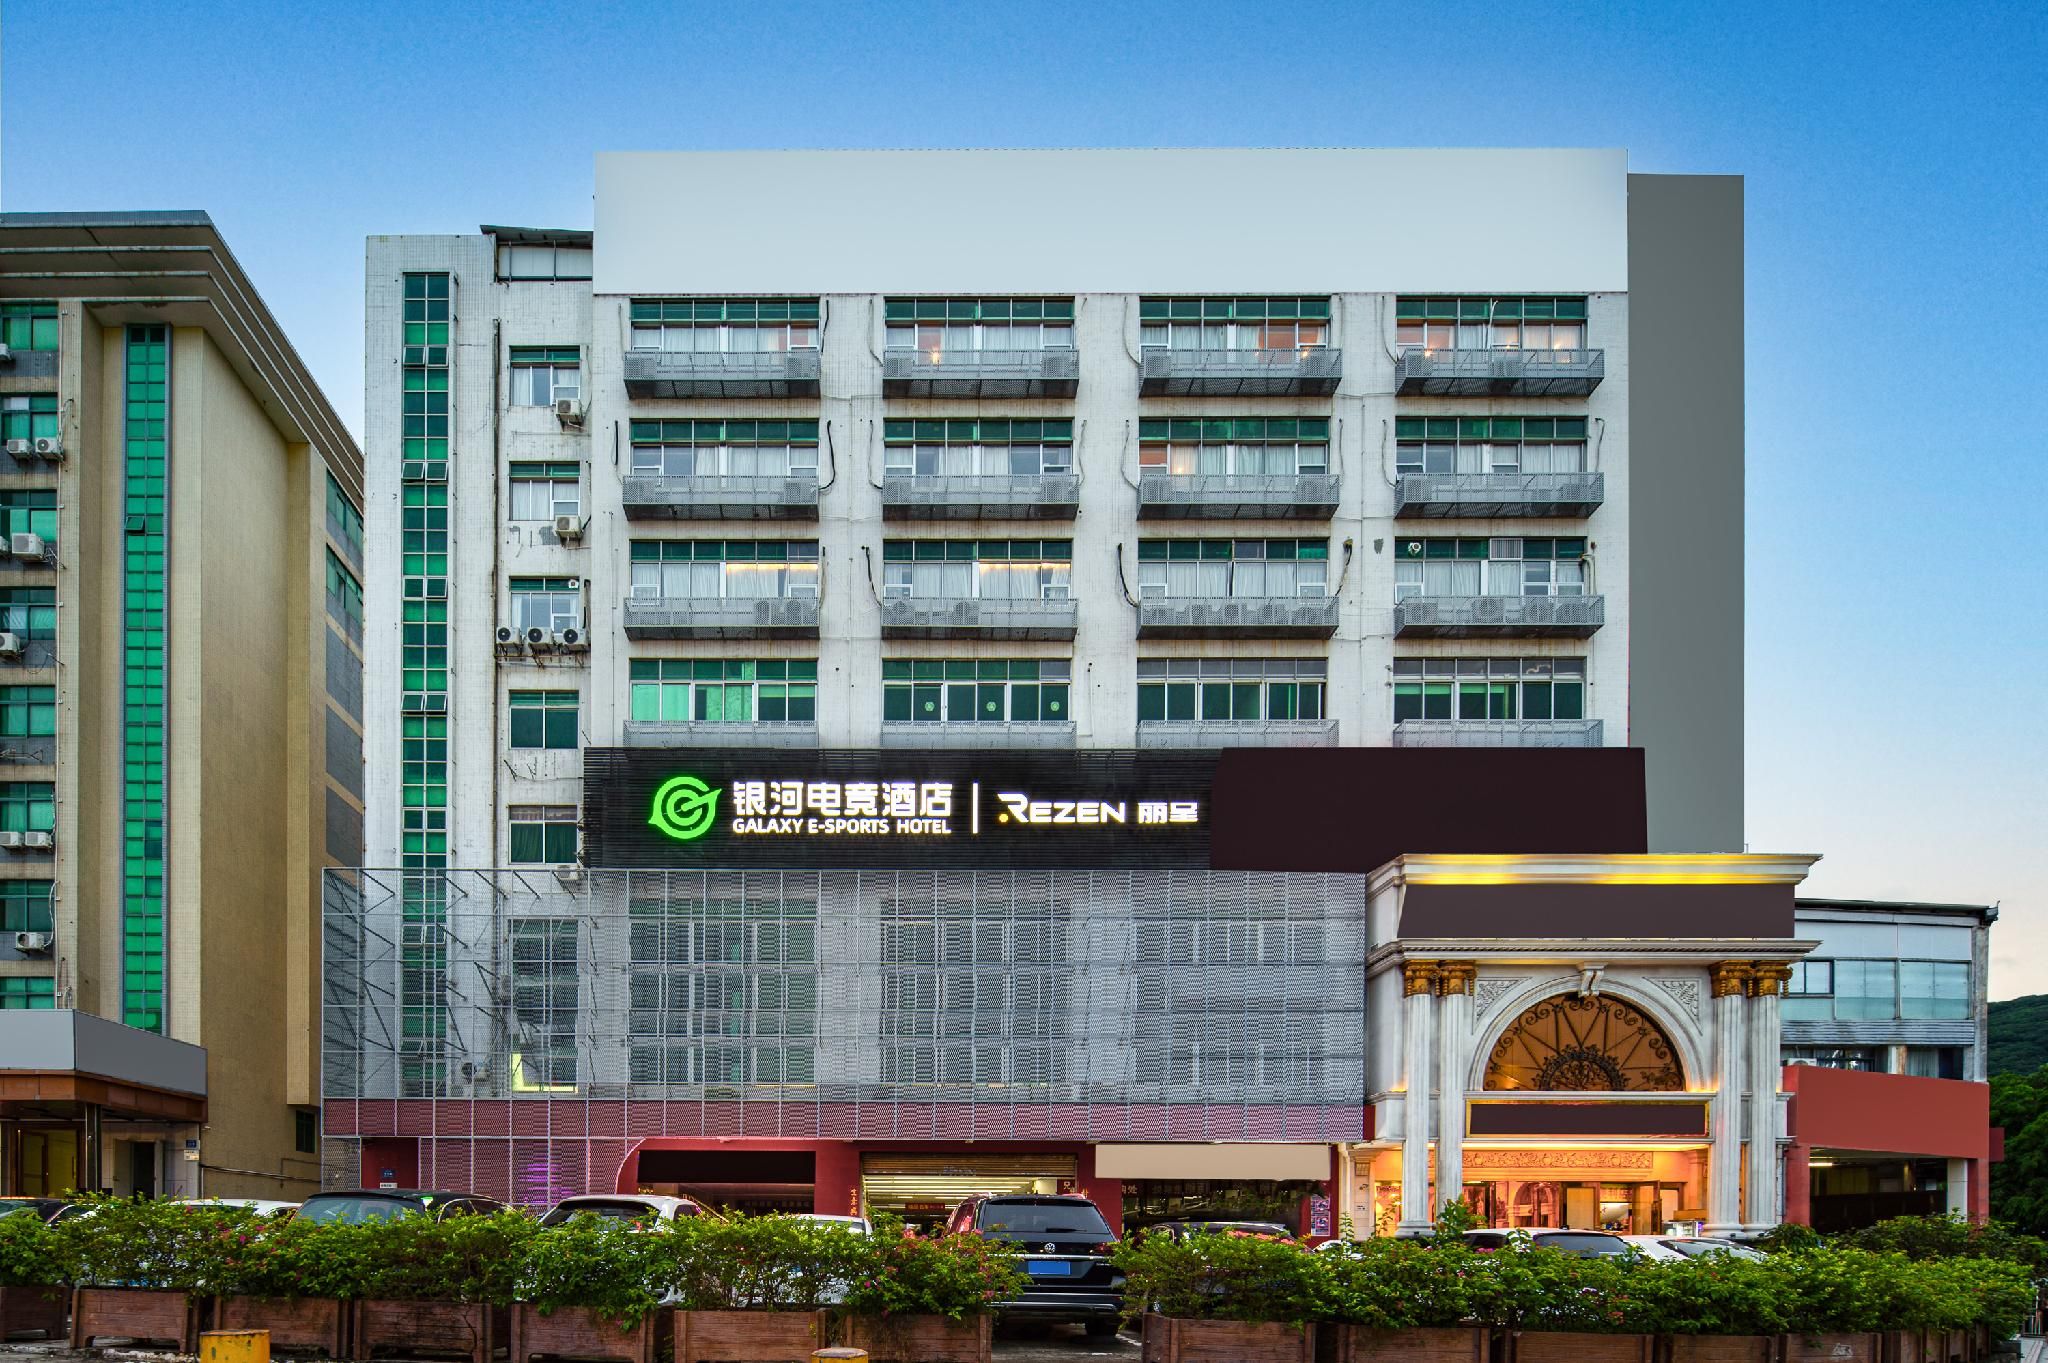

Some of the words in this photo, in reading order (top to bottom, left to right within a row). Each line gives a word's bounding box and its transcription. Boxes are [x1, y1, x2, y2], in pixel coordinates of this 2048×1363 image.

[733, 782, 952, 817] 银河电竞酒店
[1138, 802, 1199, 824] 丽呈
[732, 819, 802, 834] GALAXY
[808, 819, 889, 834] E-SPORTS
[897, 819, 951, 834] HOTEL
